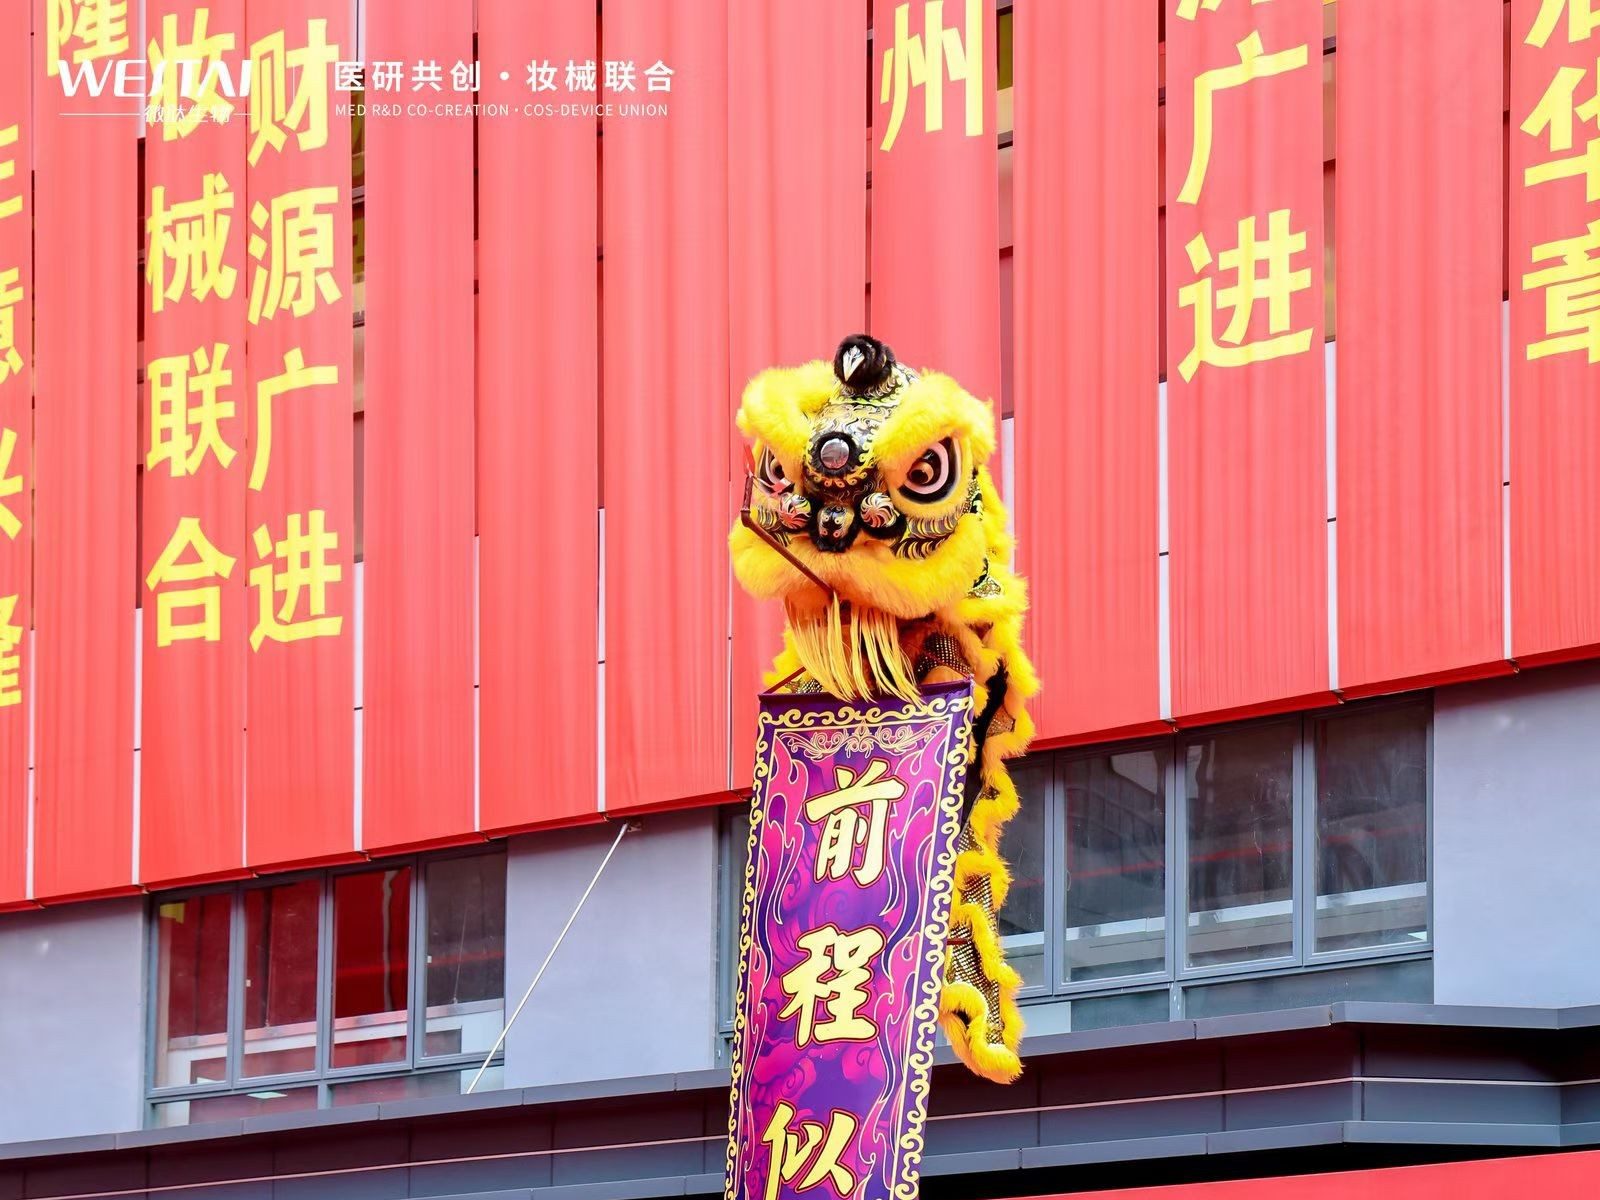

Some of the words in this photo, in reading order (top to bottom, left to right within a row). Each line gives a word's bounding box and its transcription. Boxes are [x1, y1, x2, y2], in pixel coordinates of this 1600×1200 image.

[146, 8, 237, 648] 妆械联合
[247, 18, 343, 652] 财源广进
[1176, 0, 1314, 383] 广进
